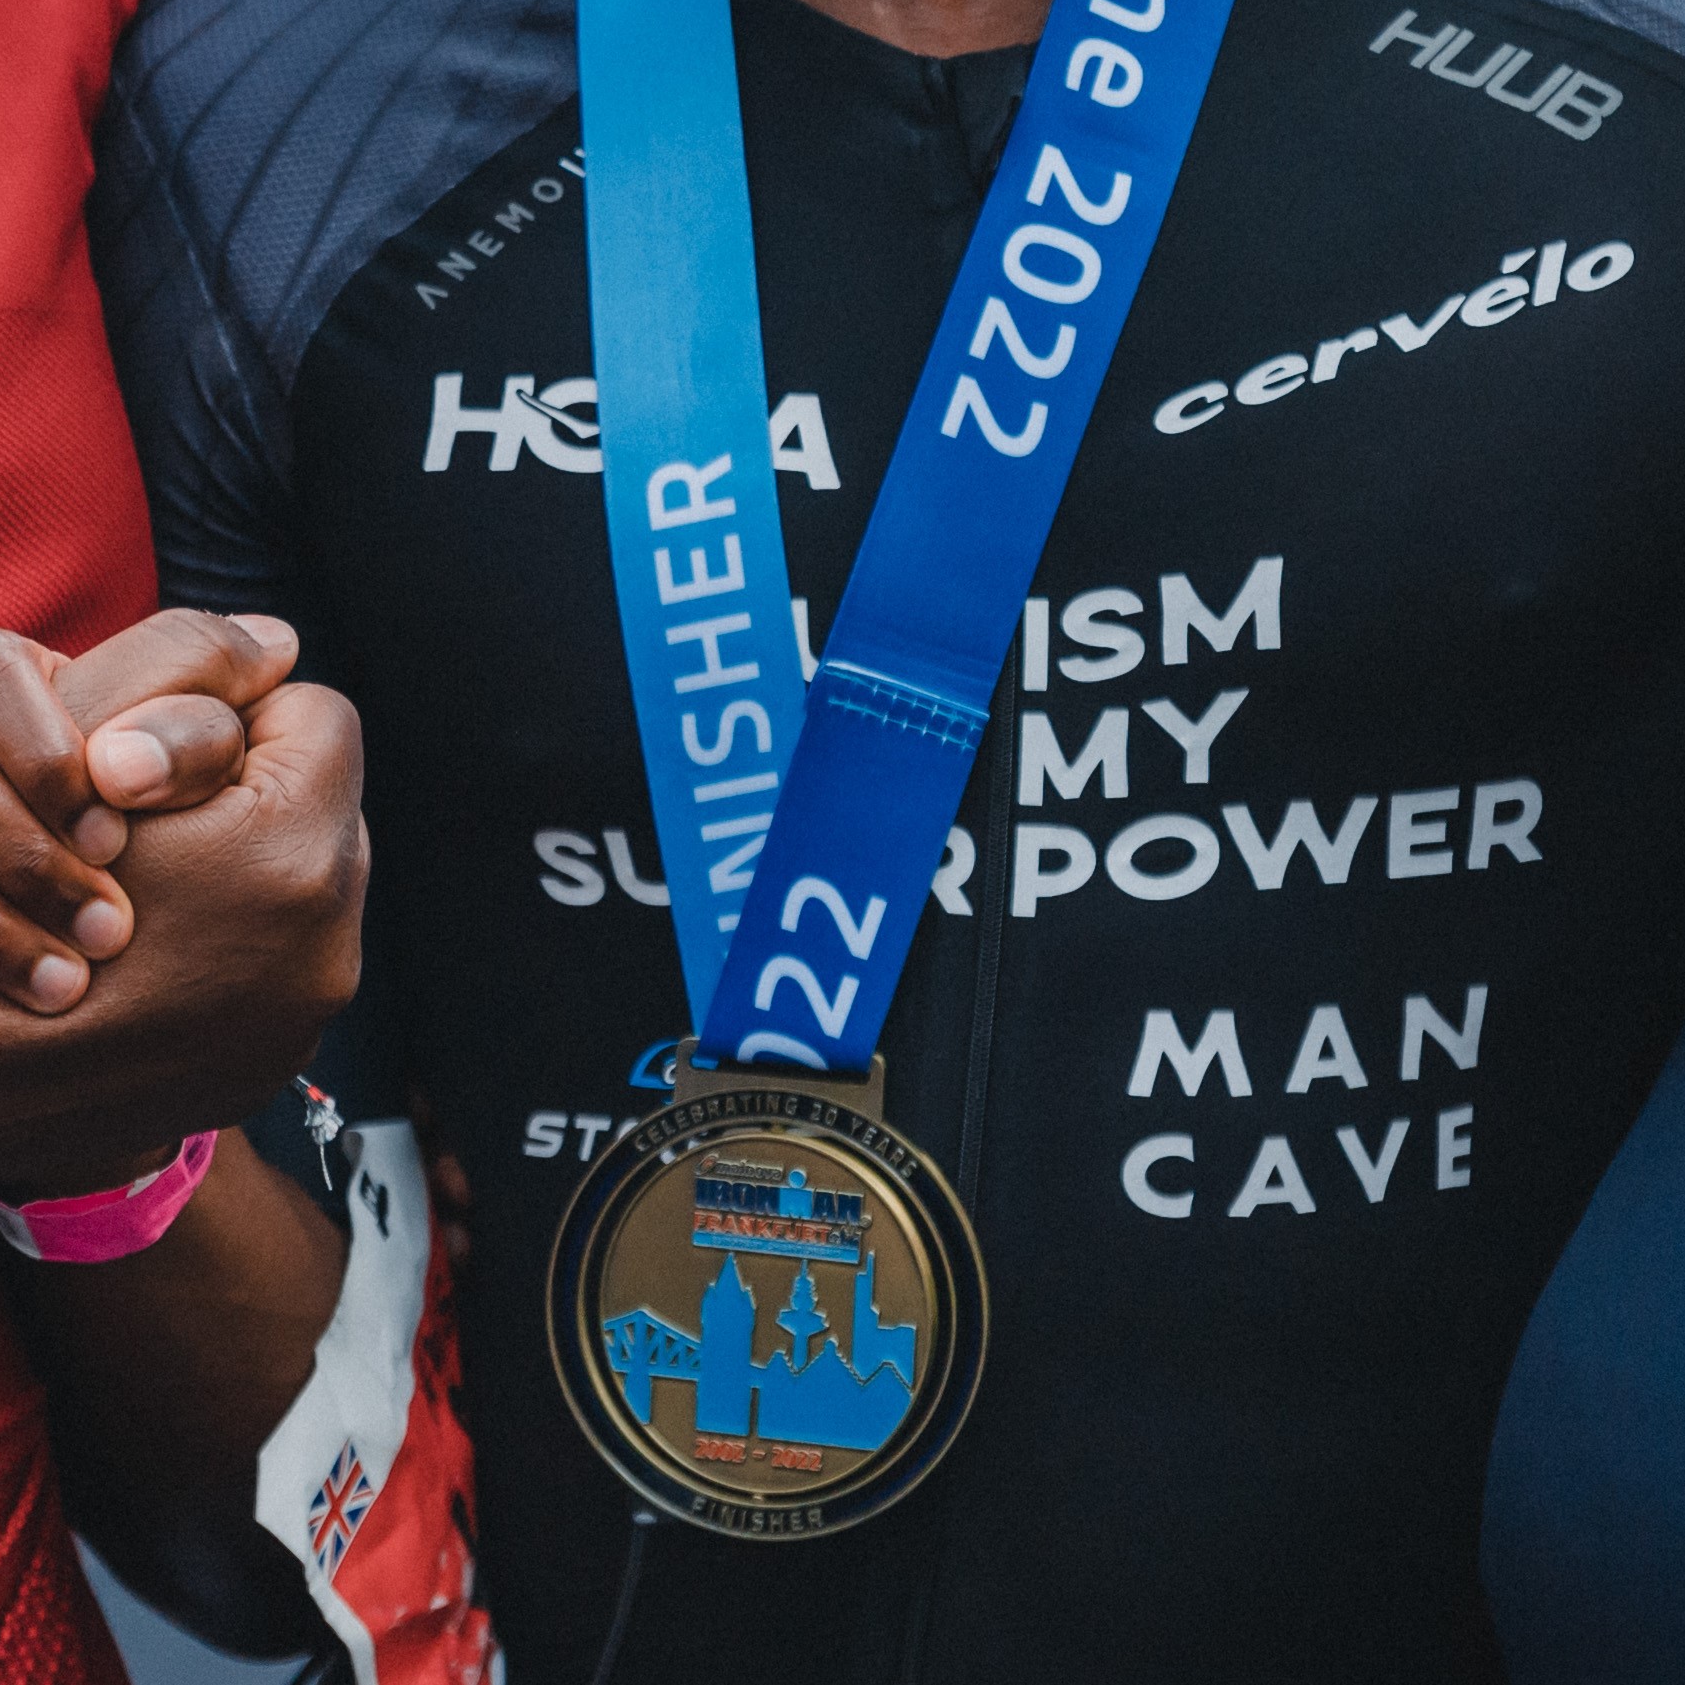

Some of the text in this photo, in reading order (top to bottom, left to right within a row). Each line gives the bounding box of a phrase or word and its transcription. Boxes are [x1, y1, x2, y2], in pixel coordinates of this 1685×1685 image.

[1369, 9, 1624, 142] HUUB
[939, 144, 1133, 459] 2022
[1153, 239, 1636, 436] cervélo
[422, 372, 842, 492] HOA
[1016, 687, 1251, 806] MY
[1126, 983, 1489, 1098] MAN
[634, 1094, 798, 1152] CELEBRATING
[811, 1101, 838, 1127] 20
[851, 1115, 917, 1179] YEARS
[1121, 1102, 1475, 1219] CAVE
[693, 1211, 832, 1244] FRANKFURT
[694, 1170, 865, 1227] IRONMAN
[694, 1437, 747, 1463] 2002
[771, 1445, 823, 1472] 2022
[692, 1496, 823, 1534] FINISHER
